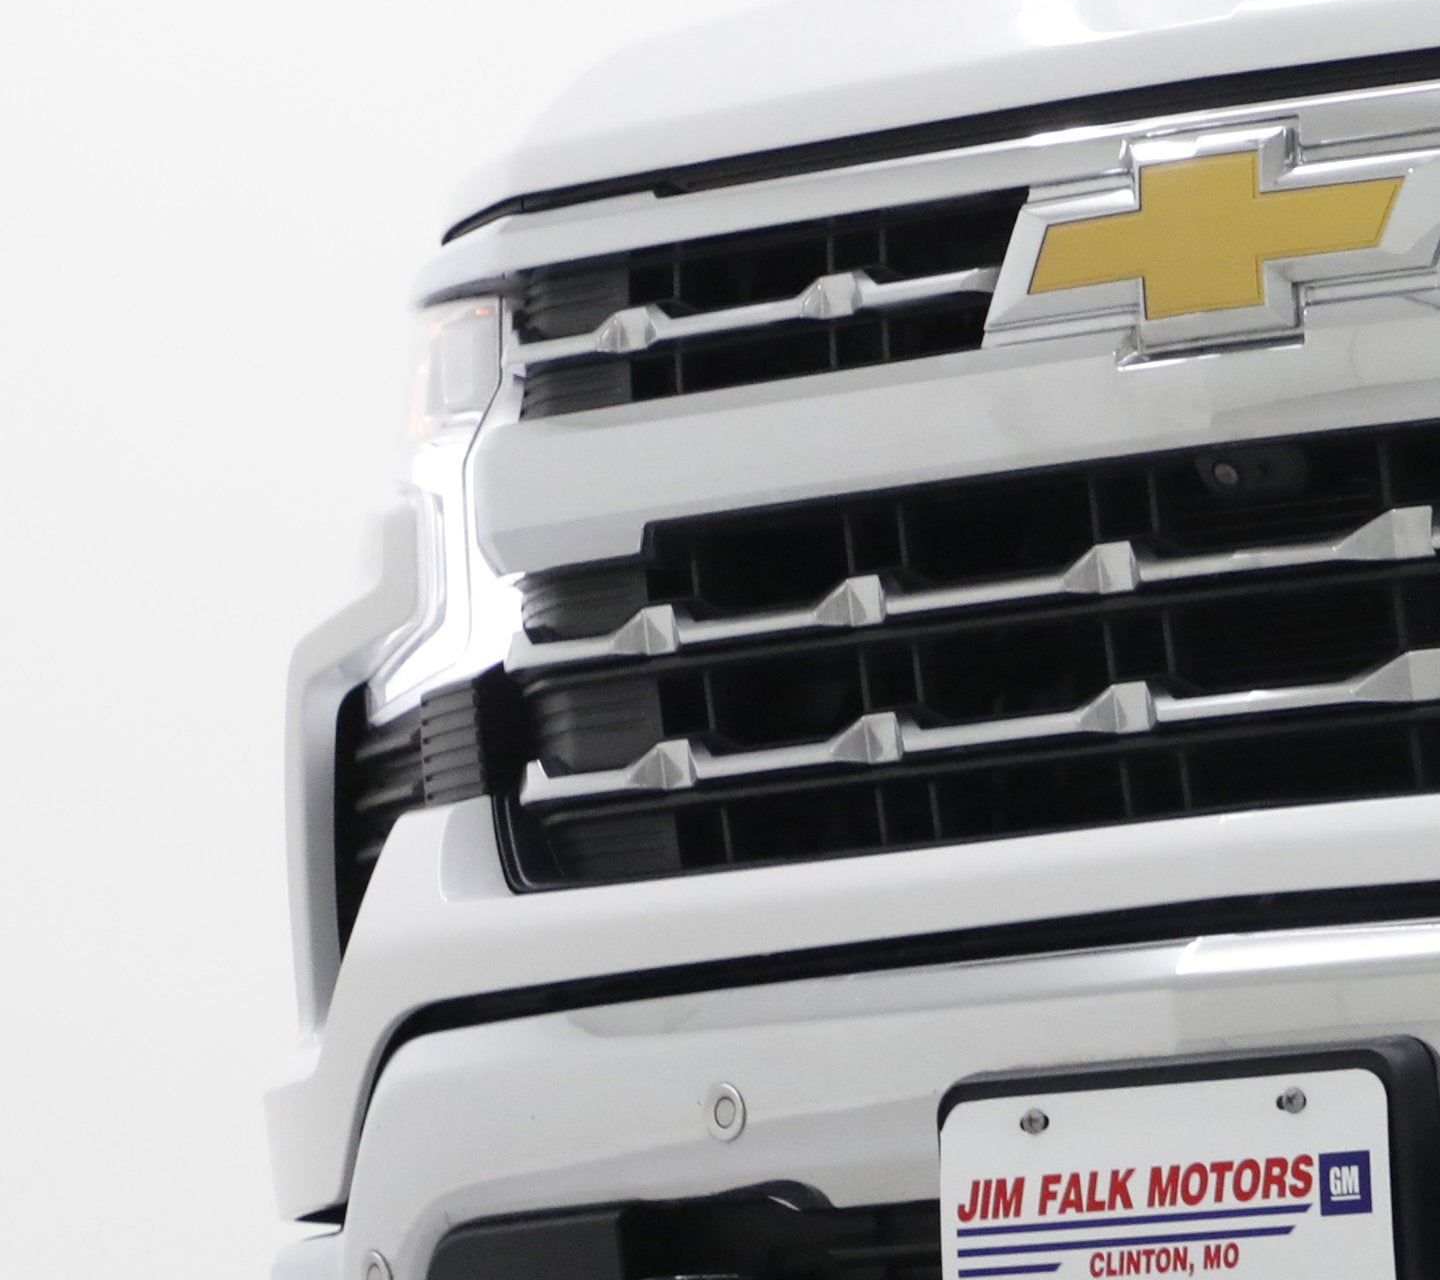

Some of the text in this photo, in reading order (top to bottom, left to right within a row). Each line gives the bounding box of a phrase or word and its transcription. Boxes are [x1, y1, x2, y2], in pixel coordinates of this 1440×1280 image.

[957, 1153, 1315, 1223] JIM FALK MOTORS
[1328, 1164, 1361, 1196] GM
[1089, 1242, 1241, 1279] CLINTON, MO
